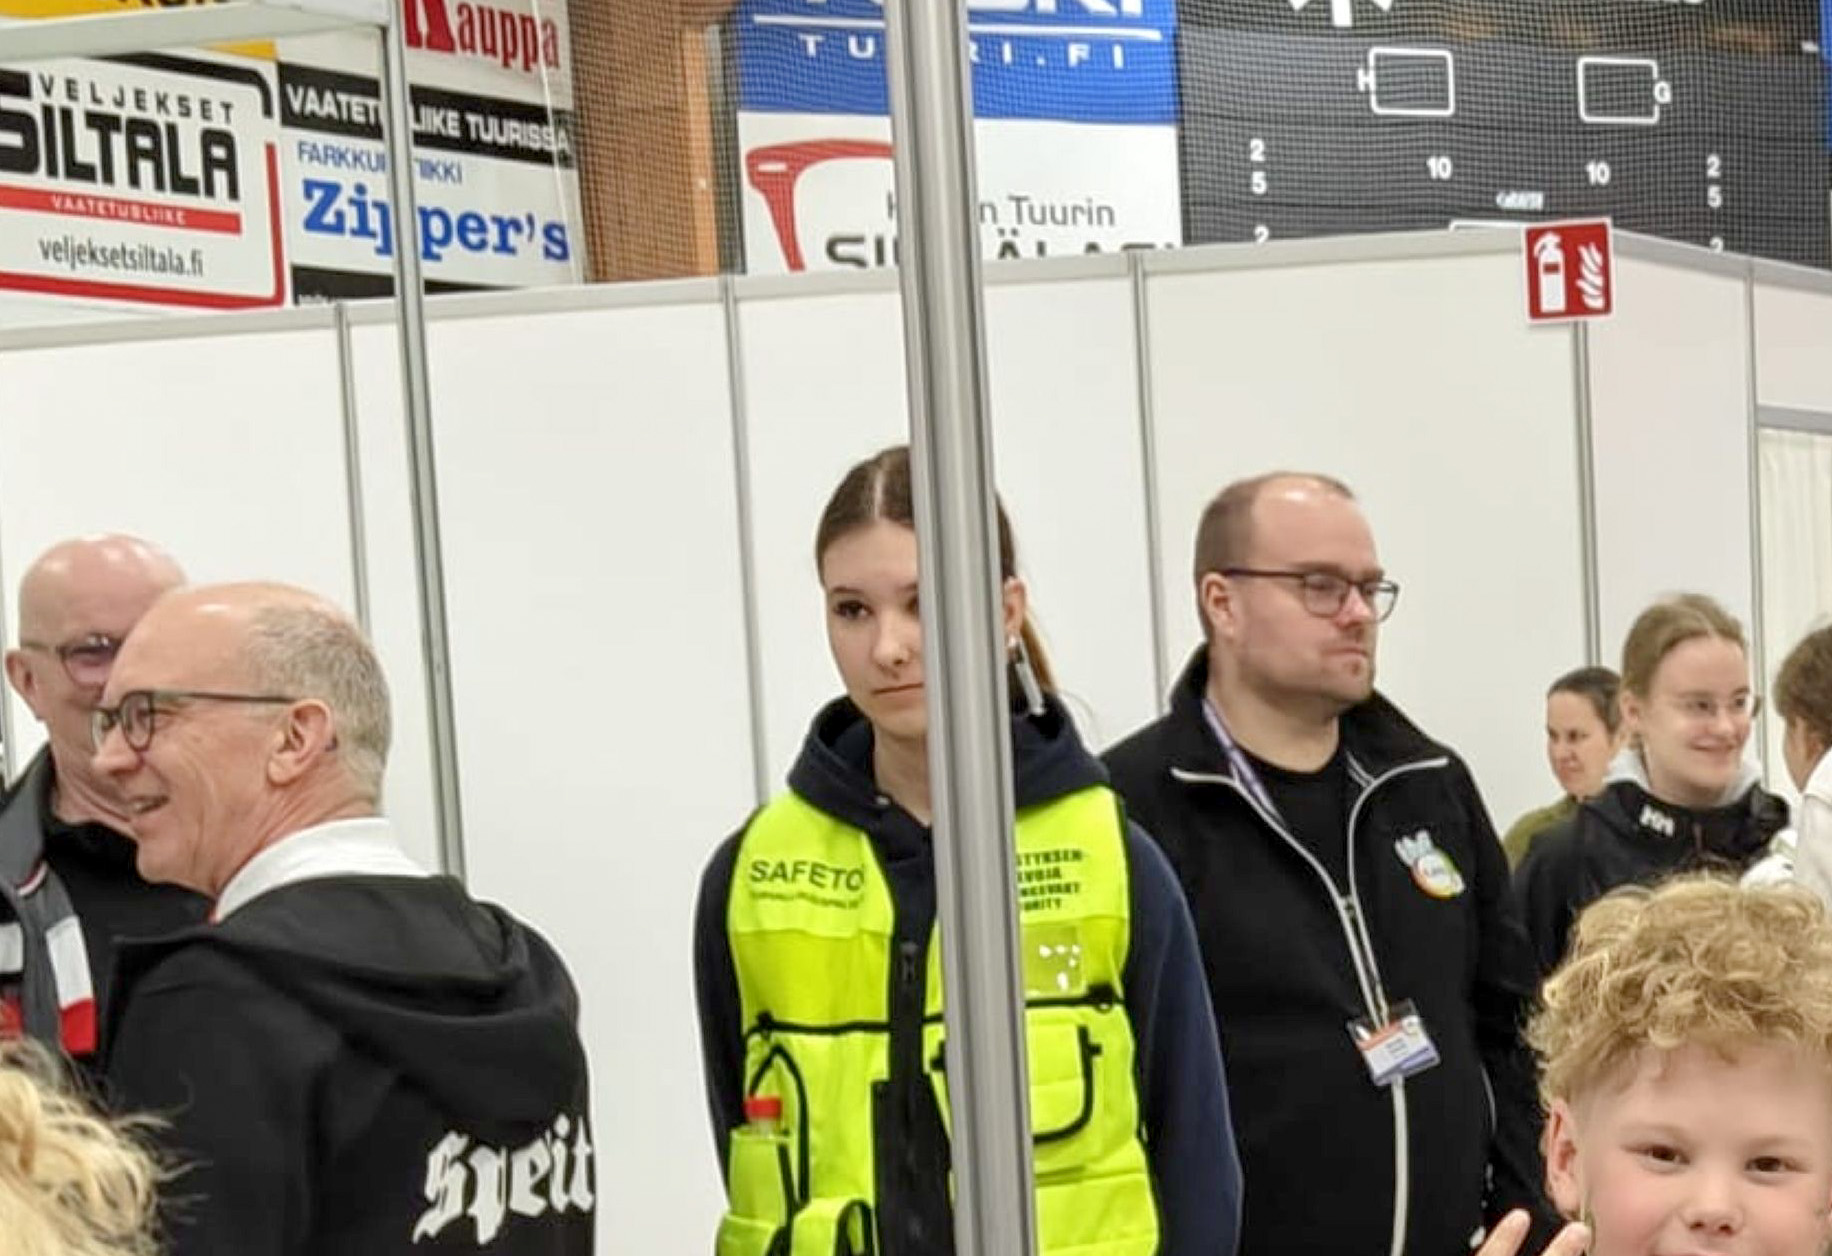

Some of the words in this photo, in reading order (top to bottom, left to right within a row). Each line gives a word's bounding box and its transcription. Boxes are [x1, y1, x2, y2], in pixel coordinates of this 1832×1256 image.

[38, 74, 234, 123] VELJEKSET
[464, 114, 570, 151] TUURISSA
[1250, 139, 1265, 161] 2
[1427, 157, 1452, 180] 10
[1587, 161, 1611, 185] 10
[1707, 155, 1721, 177] 2
[1252, 171, 1267, 194] 5
[1708, 186, 1722, 208] 5
[1008, 195, 1115, 226] Tuurin
[38, 234, 203, 277] veljeksetsiltala.fi
